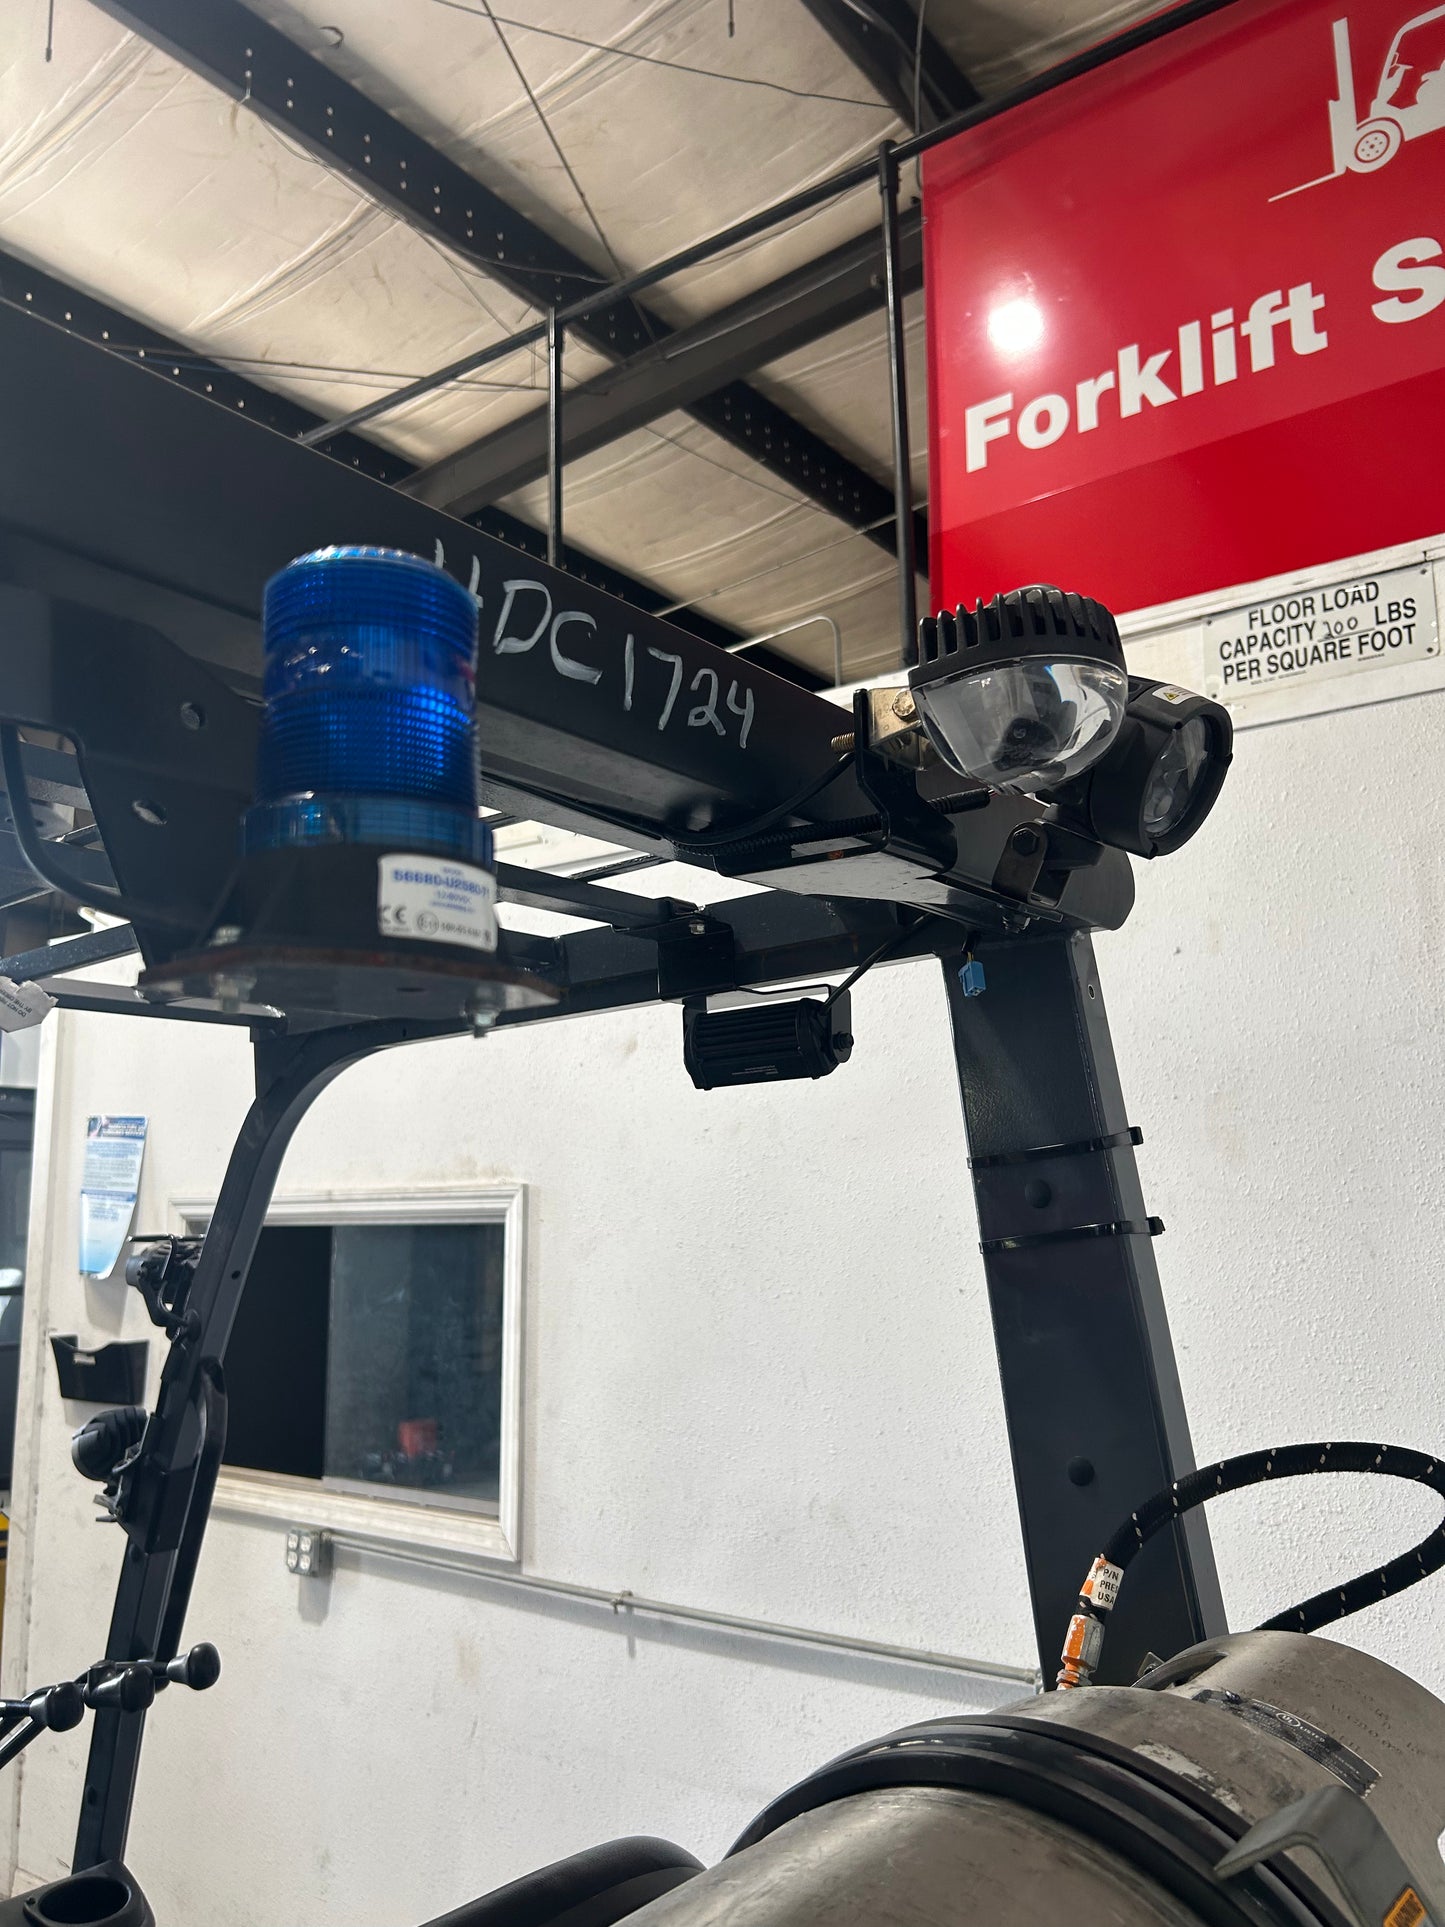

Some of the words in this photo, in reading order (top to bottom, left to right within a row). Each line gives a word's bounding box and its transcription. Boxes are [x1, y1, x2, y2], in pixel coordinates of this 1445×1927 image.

[964, 281, 1328, 474] Forklift
[1371, 236, 1445, 324] S
[1220, 620, 1317, 661] CAPACITY
[1374, 598, 1417, 627] LBS
[1248, 596, 1315, 630] FLOOR
[1322, 581, 1380, 613] LOAD
[1223, 659, 1261, 685] PER
[1267, 638, 1353, 674] SQUARE
[1358, 624, 1417, 655] FOOT
[1097, 1592, 1115, 1605] USA
[1103, 1568, 1119, 1580] P/N
